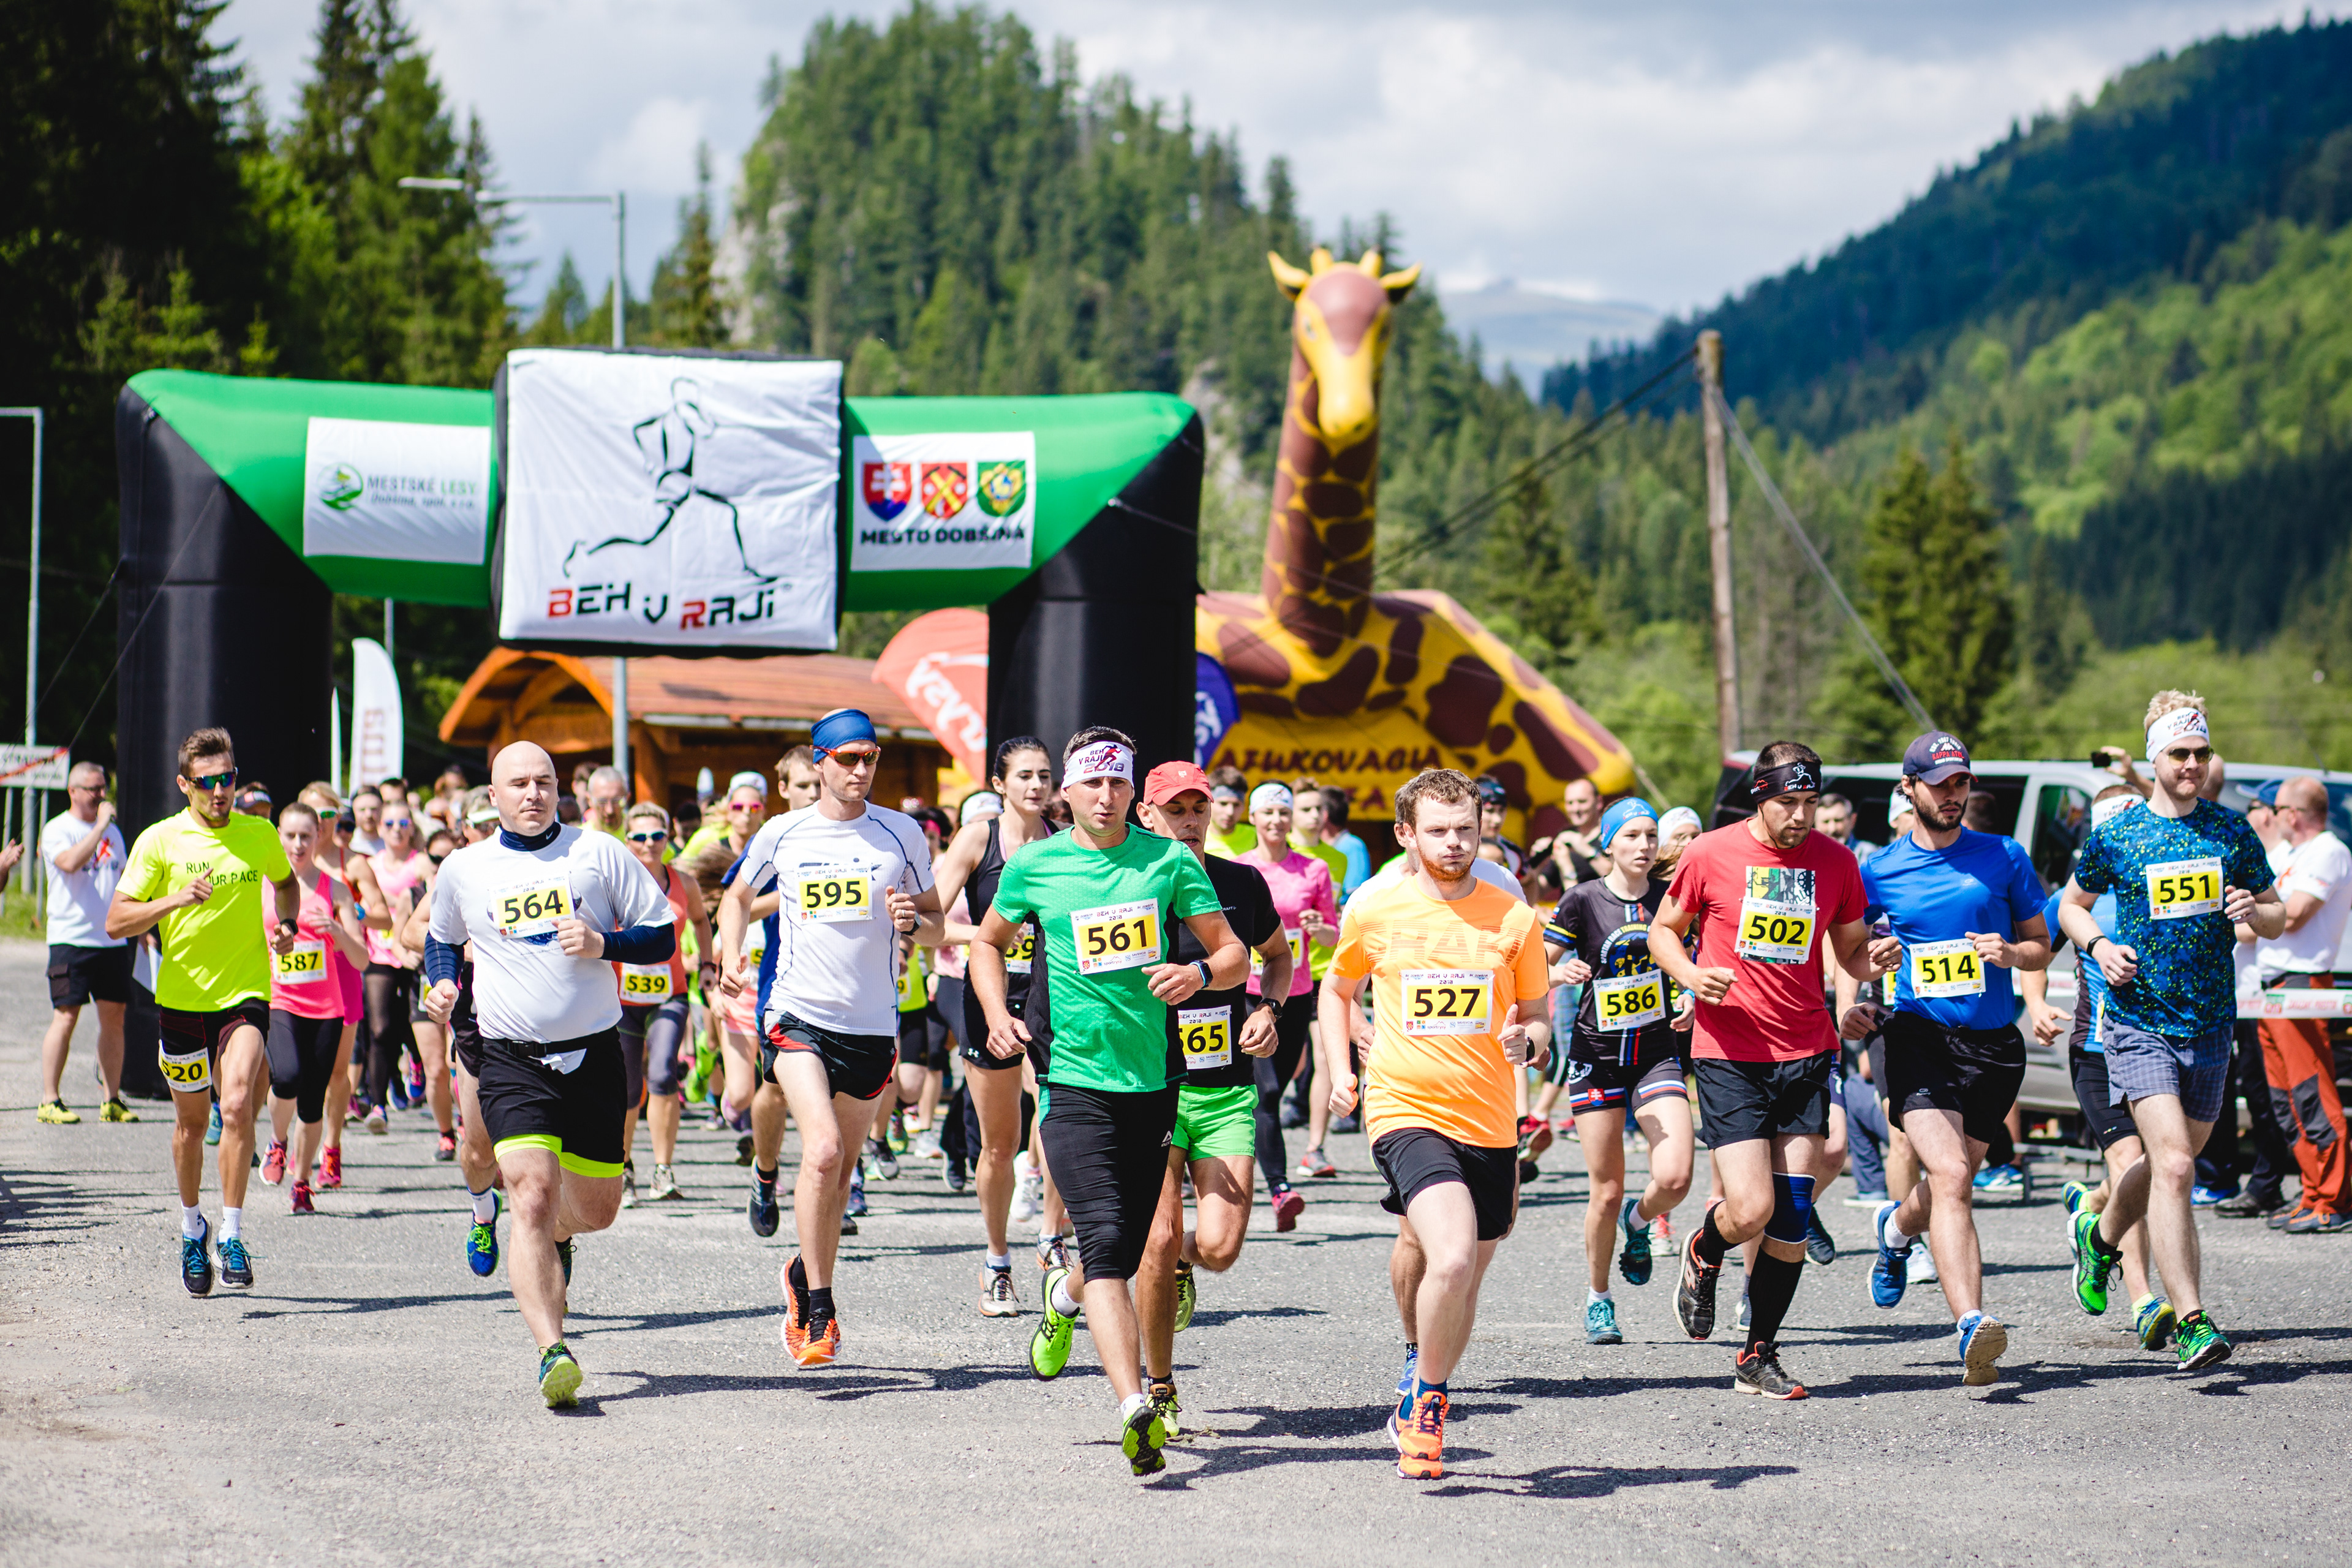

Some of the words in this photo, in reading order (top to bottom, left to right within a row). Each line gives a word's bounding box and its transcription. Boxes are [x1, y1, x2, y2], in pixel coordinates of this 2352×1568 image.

[441, 479, 477, 494] LESY
[861, 528, 930, 545] MESTO
[548, 581, 631, 619] BEH
[1084, 763, 1125, 774] 2018
[1085, 755, 1104, 763] RAJI
[1932, 751, 1950, 760] KAPPA
[186, 861, 210, 875] RUN
[231, 870, 258, 884] PACE
[807, 881, 862, 908] 595
[2160, 875, 2210, 903] 551
[505, 889, 563, 924] 564
[1088, 919, 1147, 956] 561
[1359, 919, 1529, 967] CRAFT
[1600, 939, 1613, 964] SPARTAN
[1607, 928, 1623, 943] RACE
[1620, 923, 1648, 933] TRAINING
[1748, 915, 1804, 945] 502
[281, 952, 318, 973] 587
[1922, 954, 1975, 983] 514
[627, 976, 665, 993] 539
[1414, 988, 1480, 1017] 527
[1607, 986, 1656, 1016] 586
[162, 1058, 203, 1082] 520
